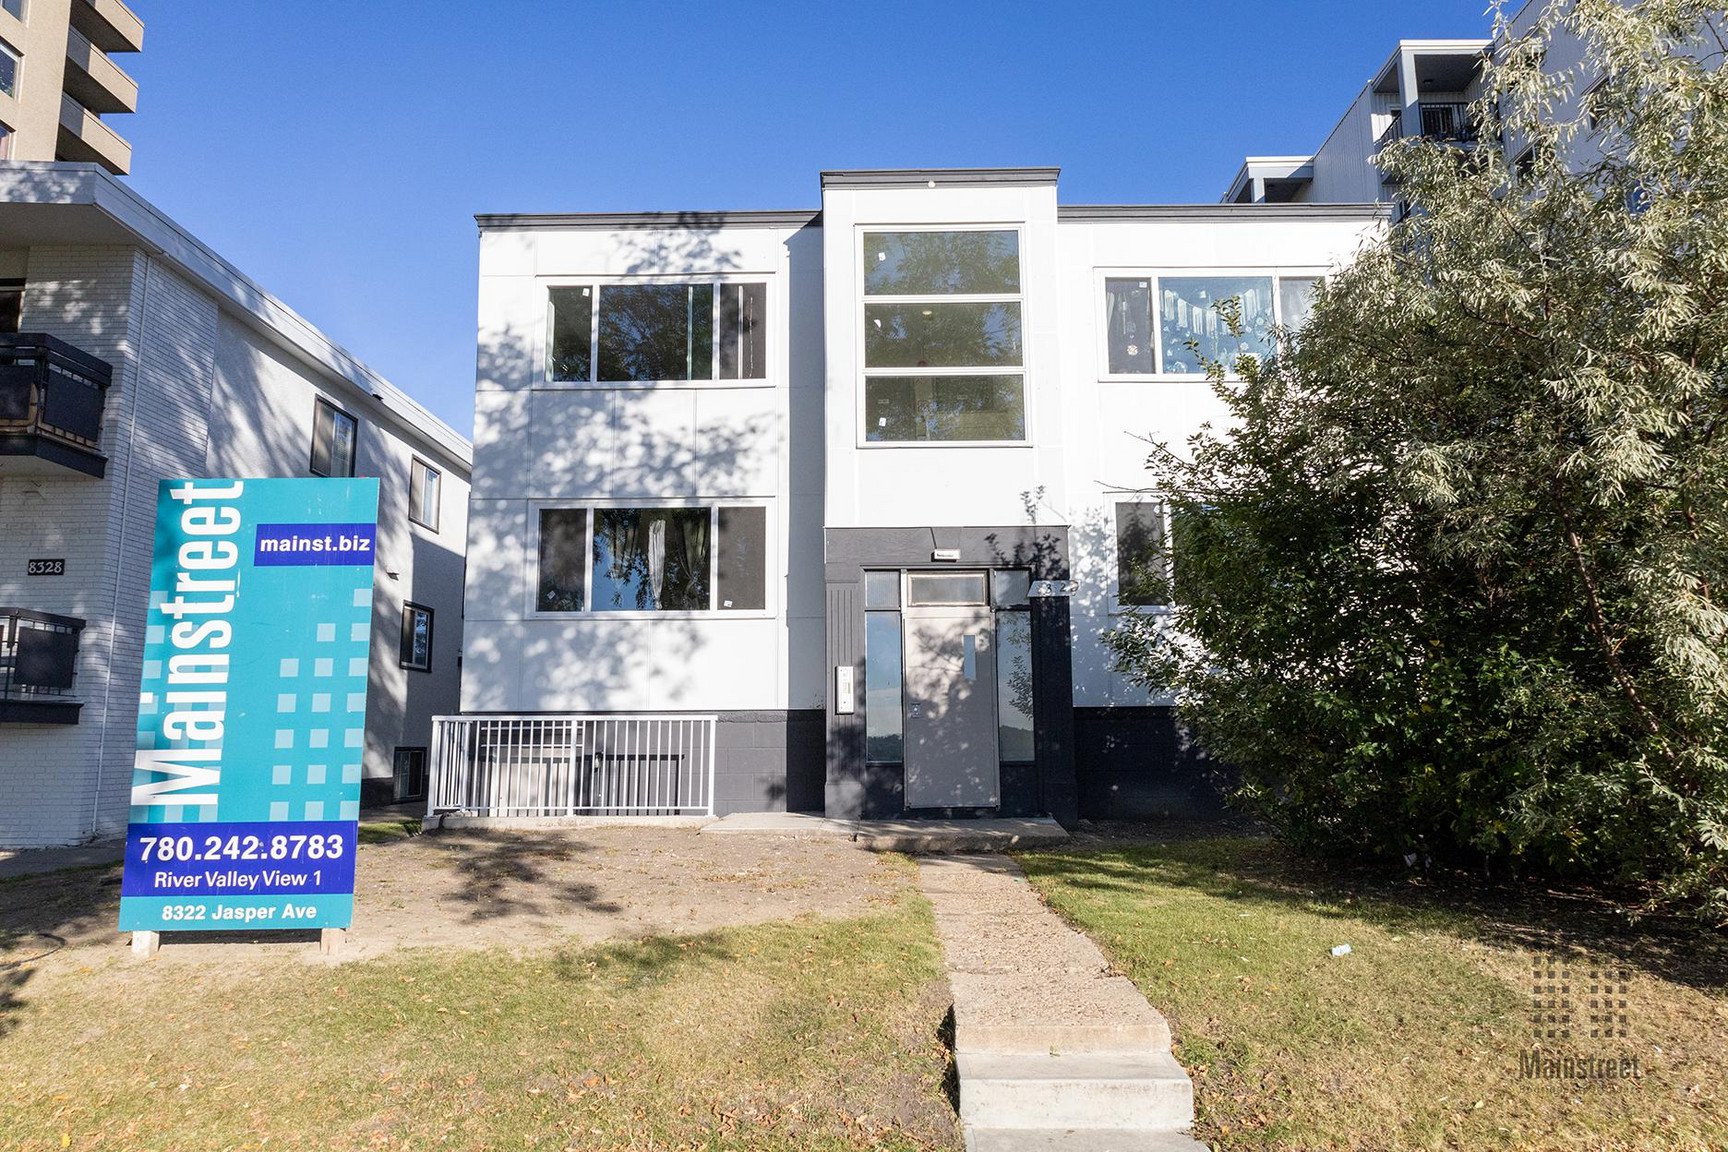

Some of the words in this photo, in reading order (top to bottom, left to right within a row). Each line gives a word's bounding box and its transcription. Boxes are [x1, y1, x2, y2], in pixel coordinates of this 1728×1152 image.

[260, 535, 370, 552] mainst.biz
[28, 561, 62, 573] 8328
[131, 481, 244, 806] Mainstreet
[139, 834, 343, 862] 780.242.8783
[154, 871, 202, 888] River
[205, 870, 259, 890] Valley
[262, 870, 307, 886] View
[313, 870, 321, 886] 1
[162, 905, 206, 921] 8322
[212, 904, 275, 922] Jasper
[282, 903, 317, 919] Ave
